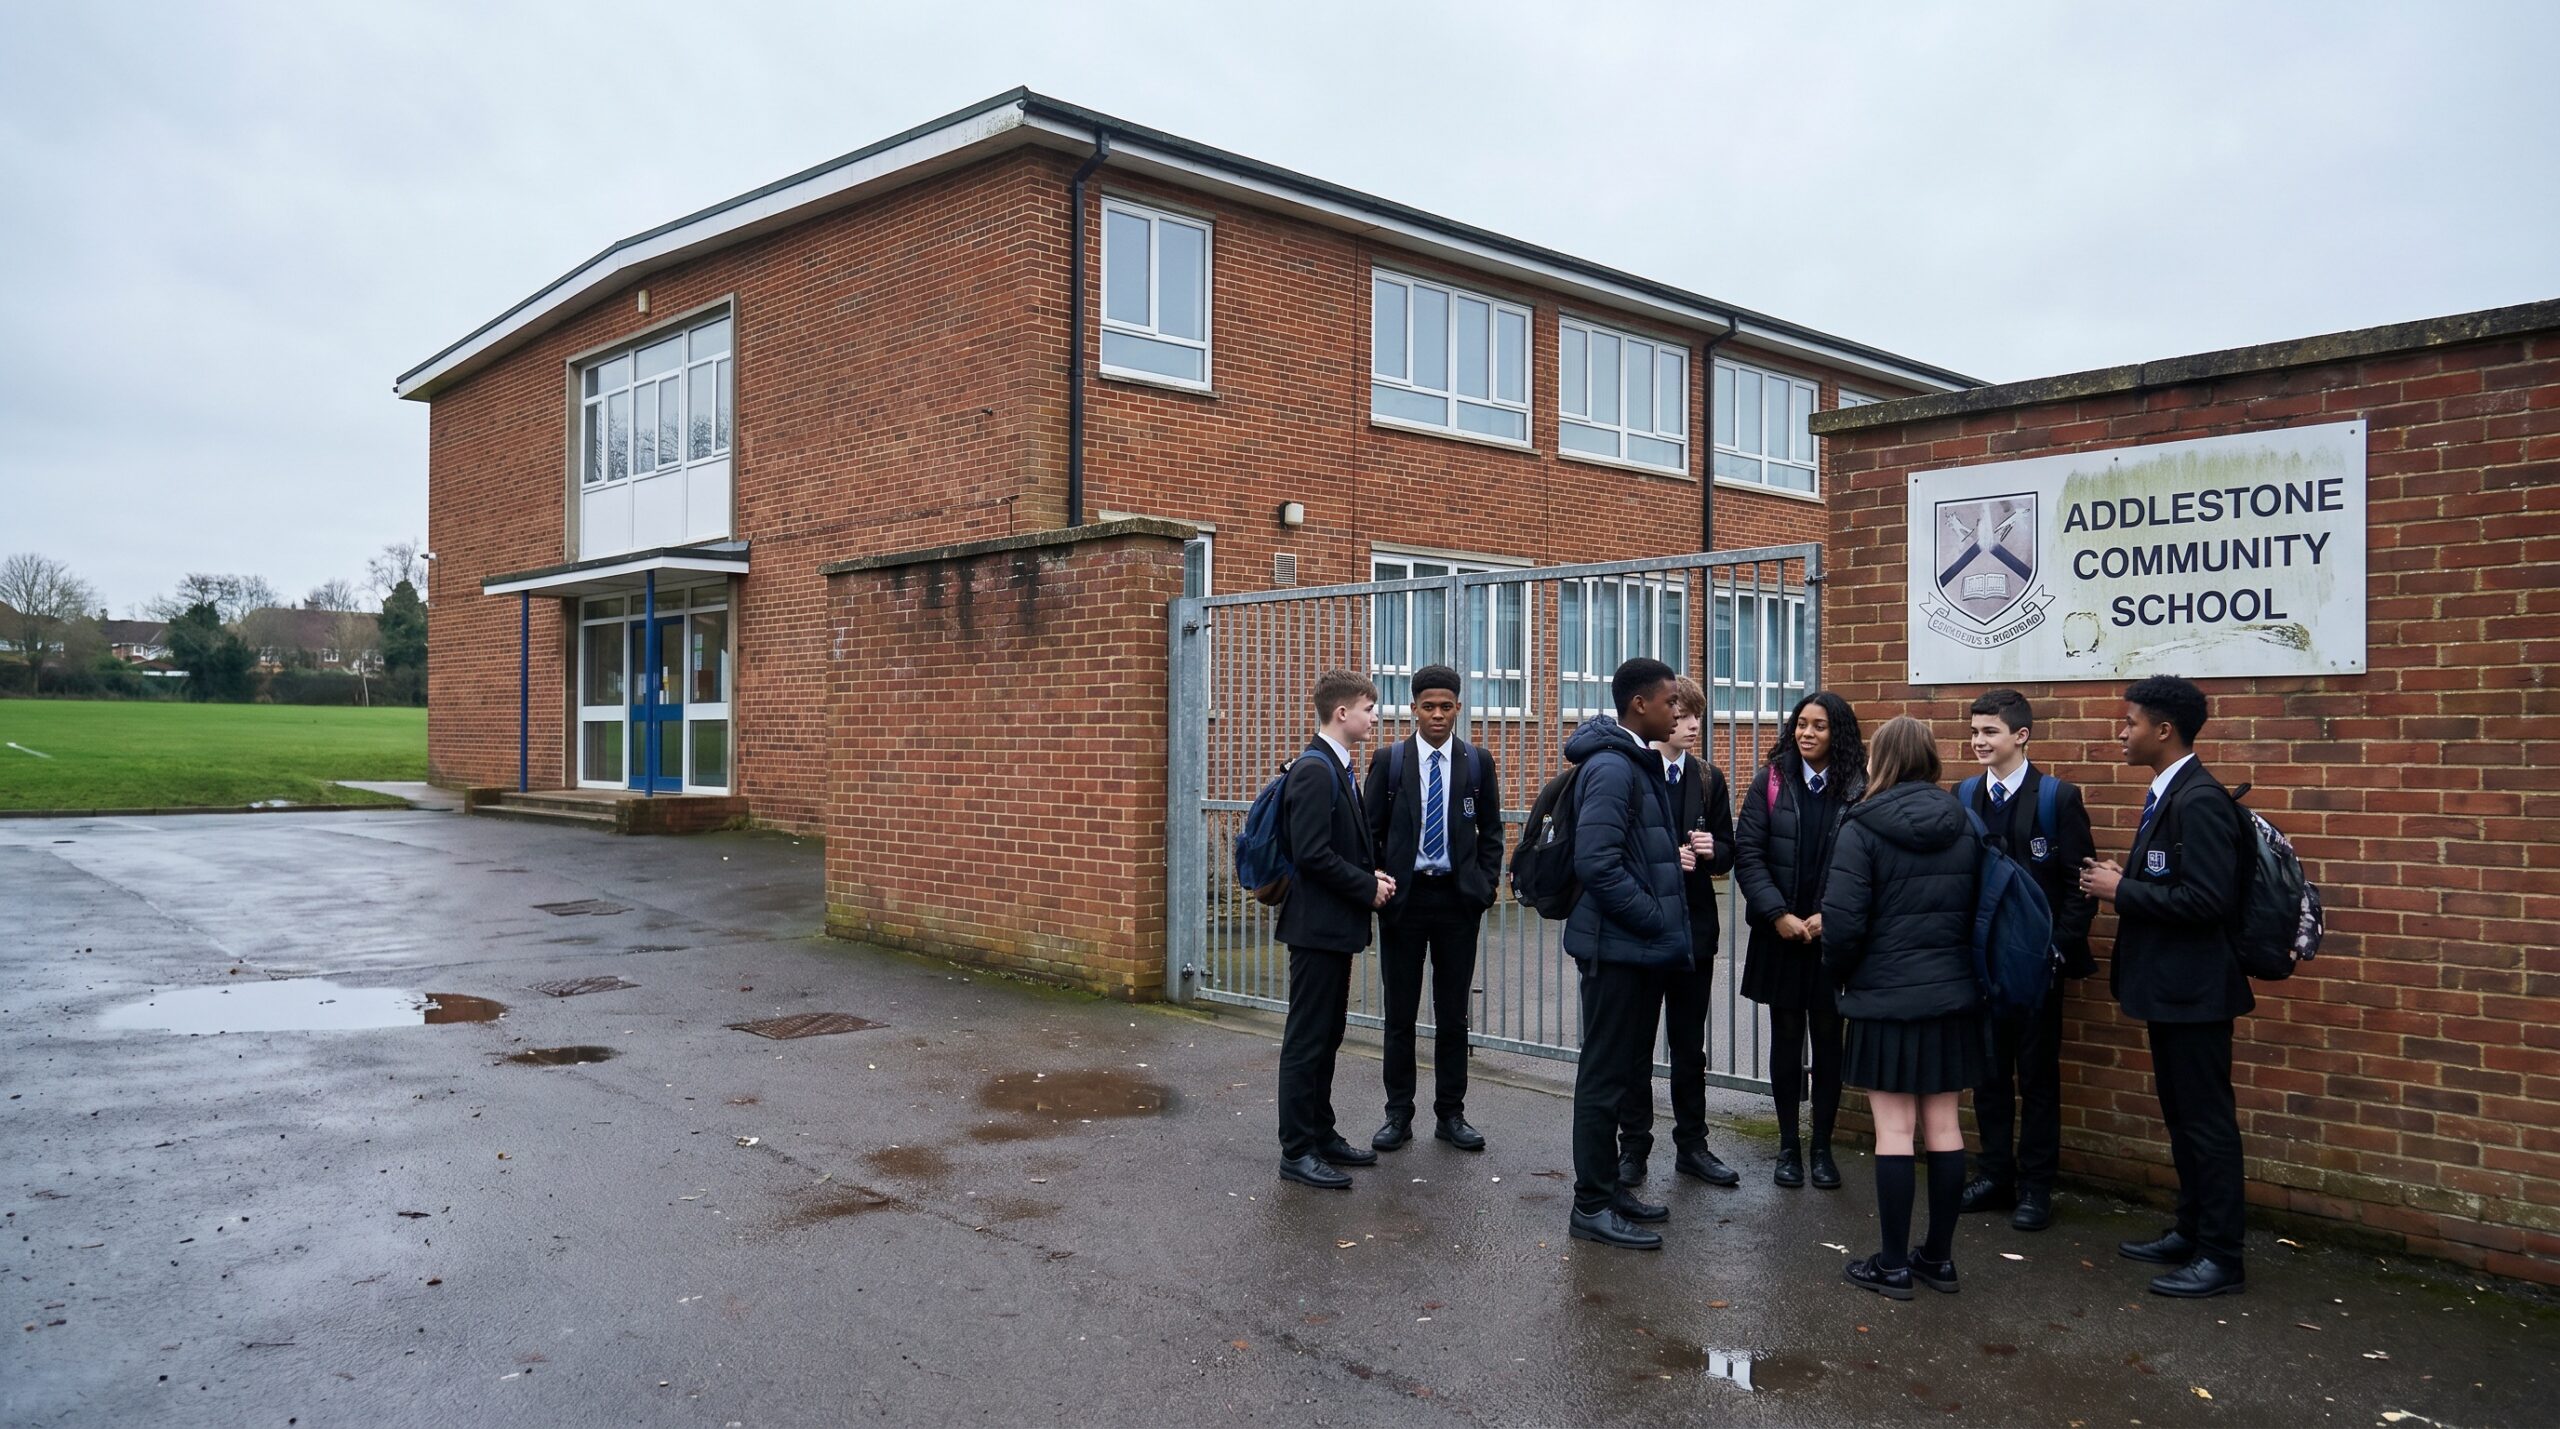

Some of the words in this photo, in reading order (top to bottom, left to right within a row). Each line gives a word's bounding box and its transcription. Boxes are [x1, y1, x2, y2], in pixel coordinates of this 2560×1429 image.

[2063, 477, 2344, 533] ADDLESTONE
[2073, 531, 2331, 580] COMMUNITY
[2111, 588, 2288, 627] SCHOOL
